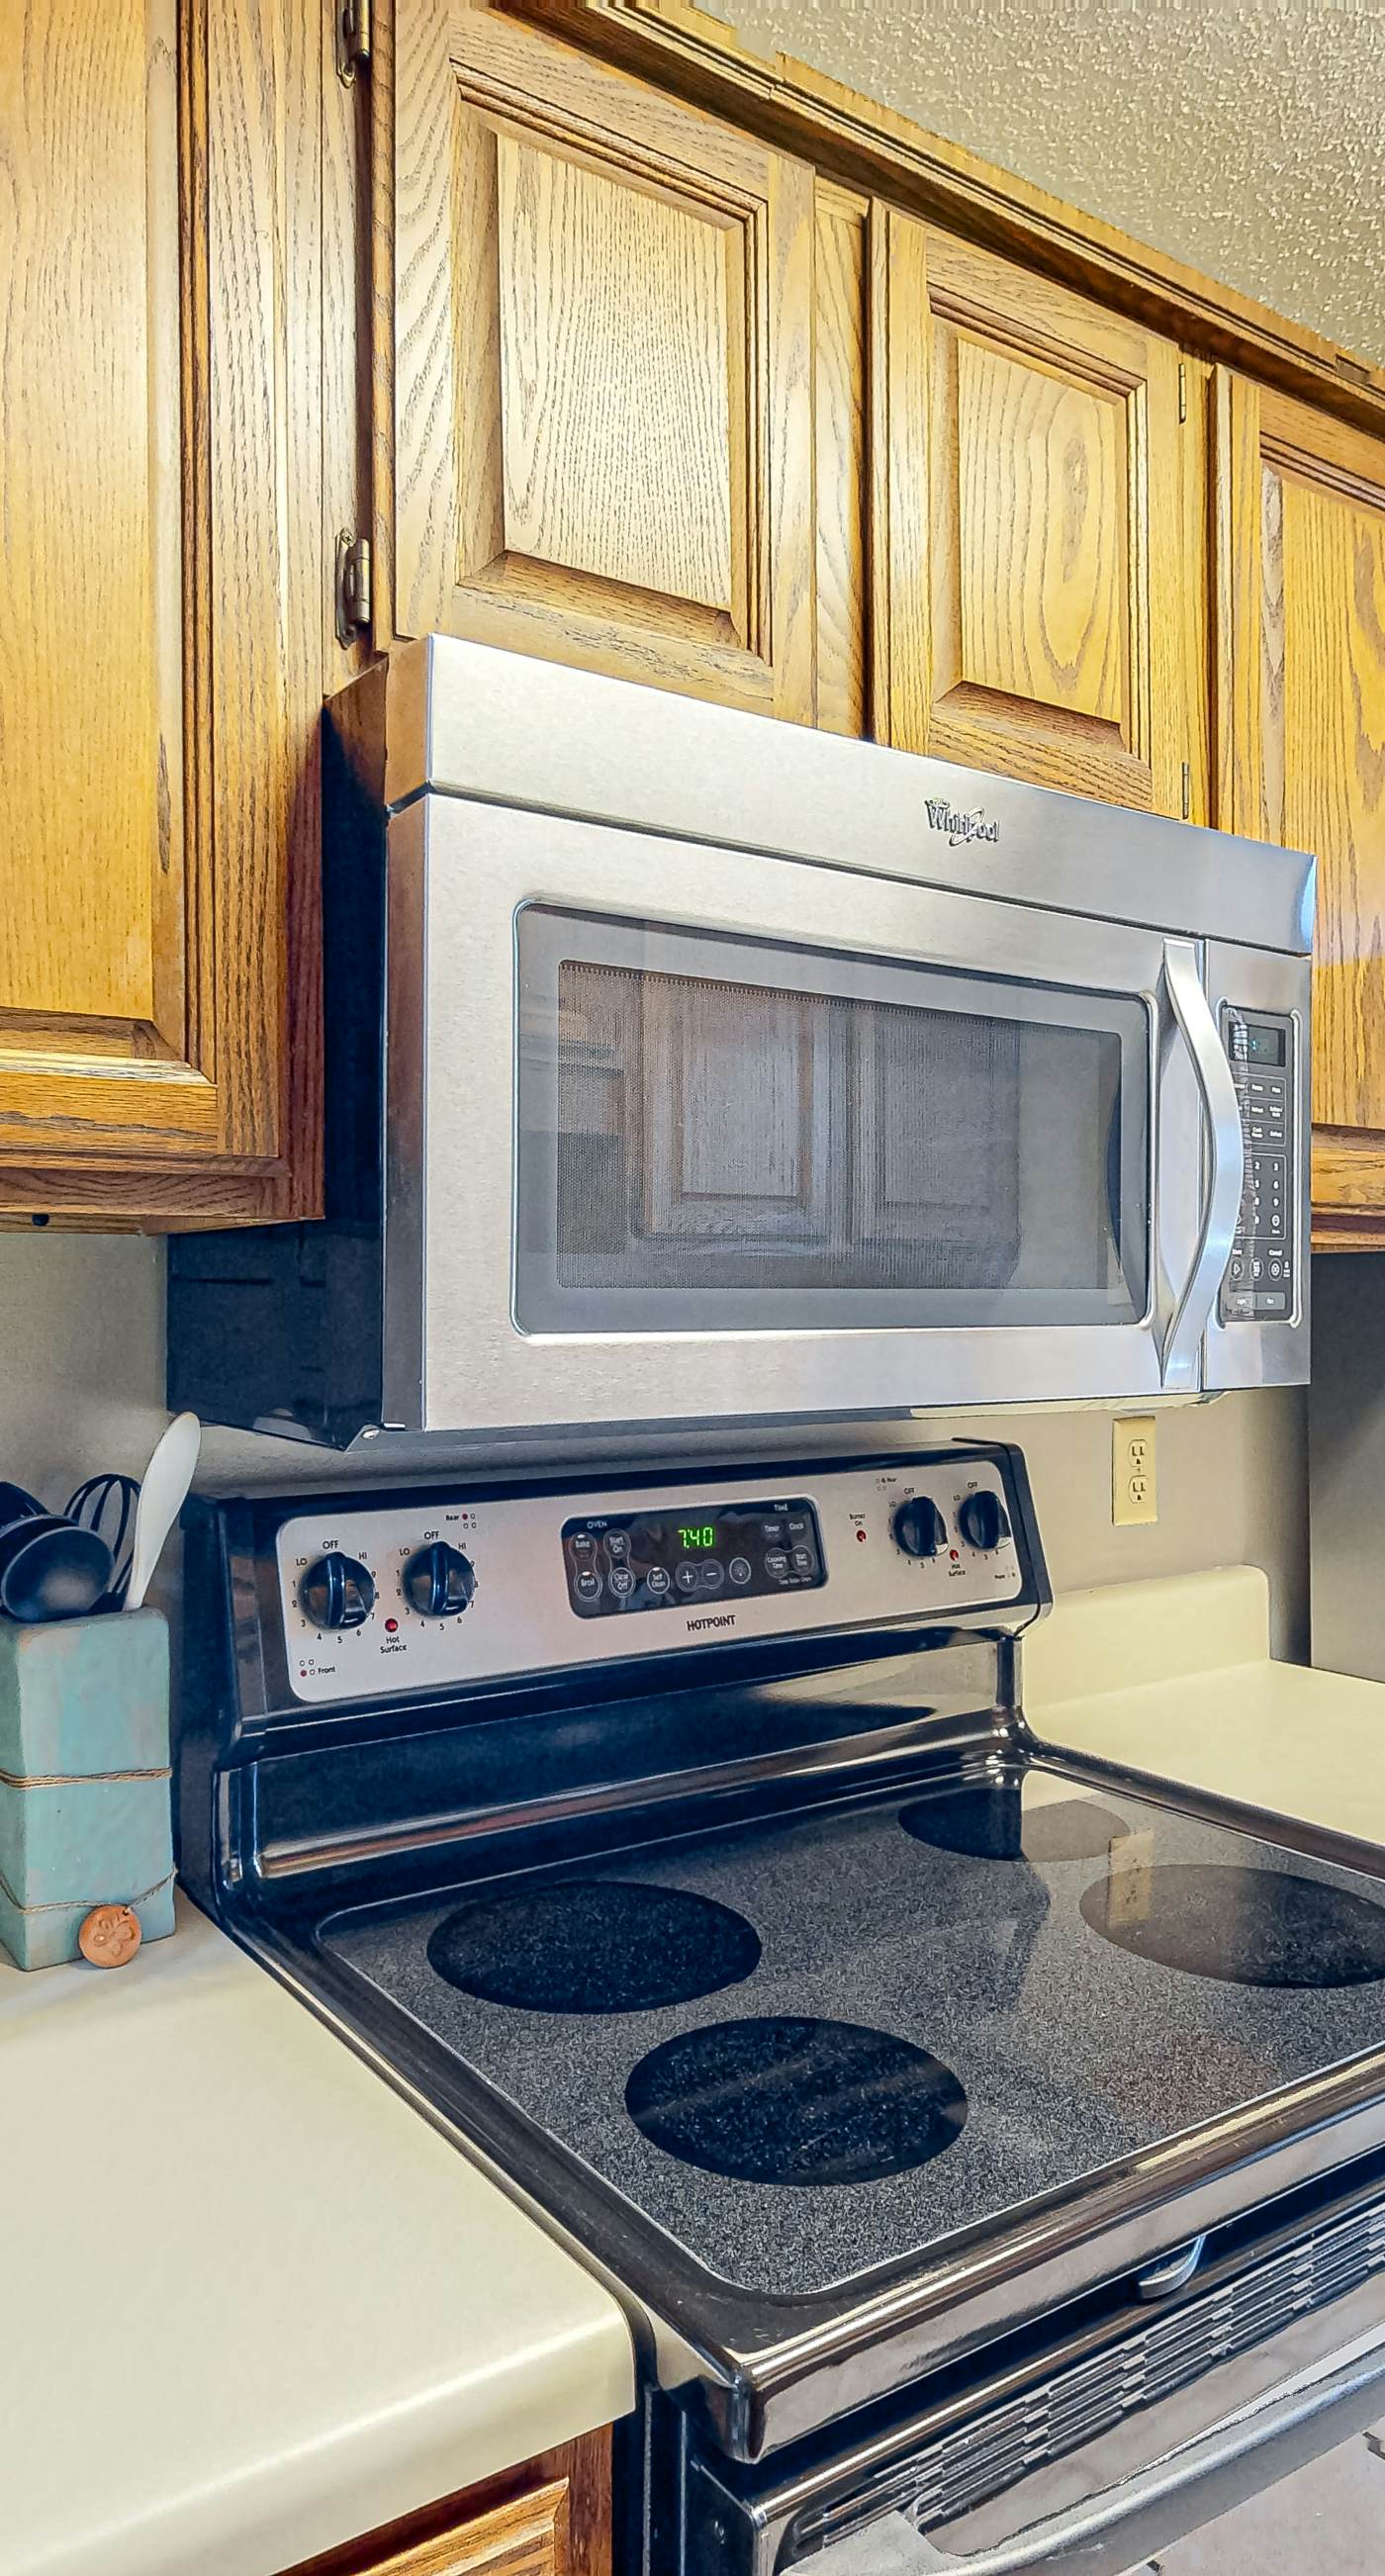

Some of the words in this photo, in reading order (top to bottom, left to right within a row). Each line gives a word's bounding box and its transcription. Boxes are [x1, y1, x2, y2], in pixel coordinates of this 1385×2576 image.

[924, 797, 999, 847] Whirlpool
[587, 1520, 607, 1529] OVEN
[423, 1530, 440, 1540] OFF
[678, 1526, 713, 1549] 7:40
[322, 1540, 339, 1550] OFF
[358, 1551, 368, 1560] HI
[581, 1578, 595, 1587] Broil
[687, 1614, 736, 1631] HOTPOINT
[380, 1644, 408, 1654] Surface
[318, 1666, 336, 1675] Front
